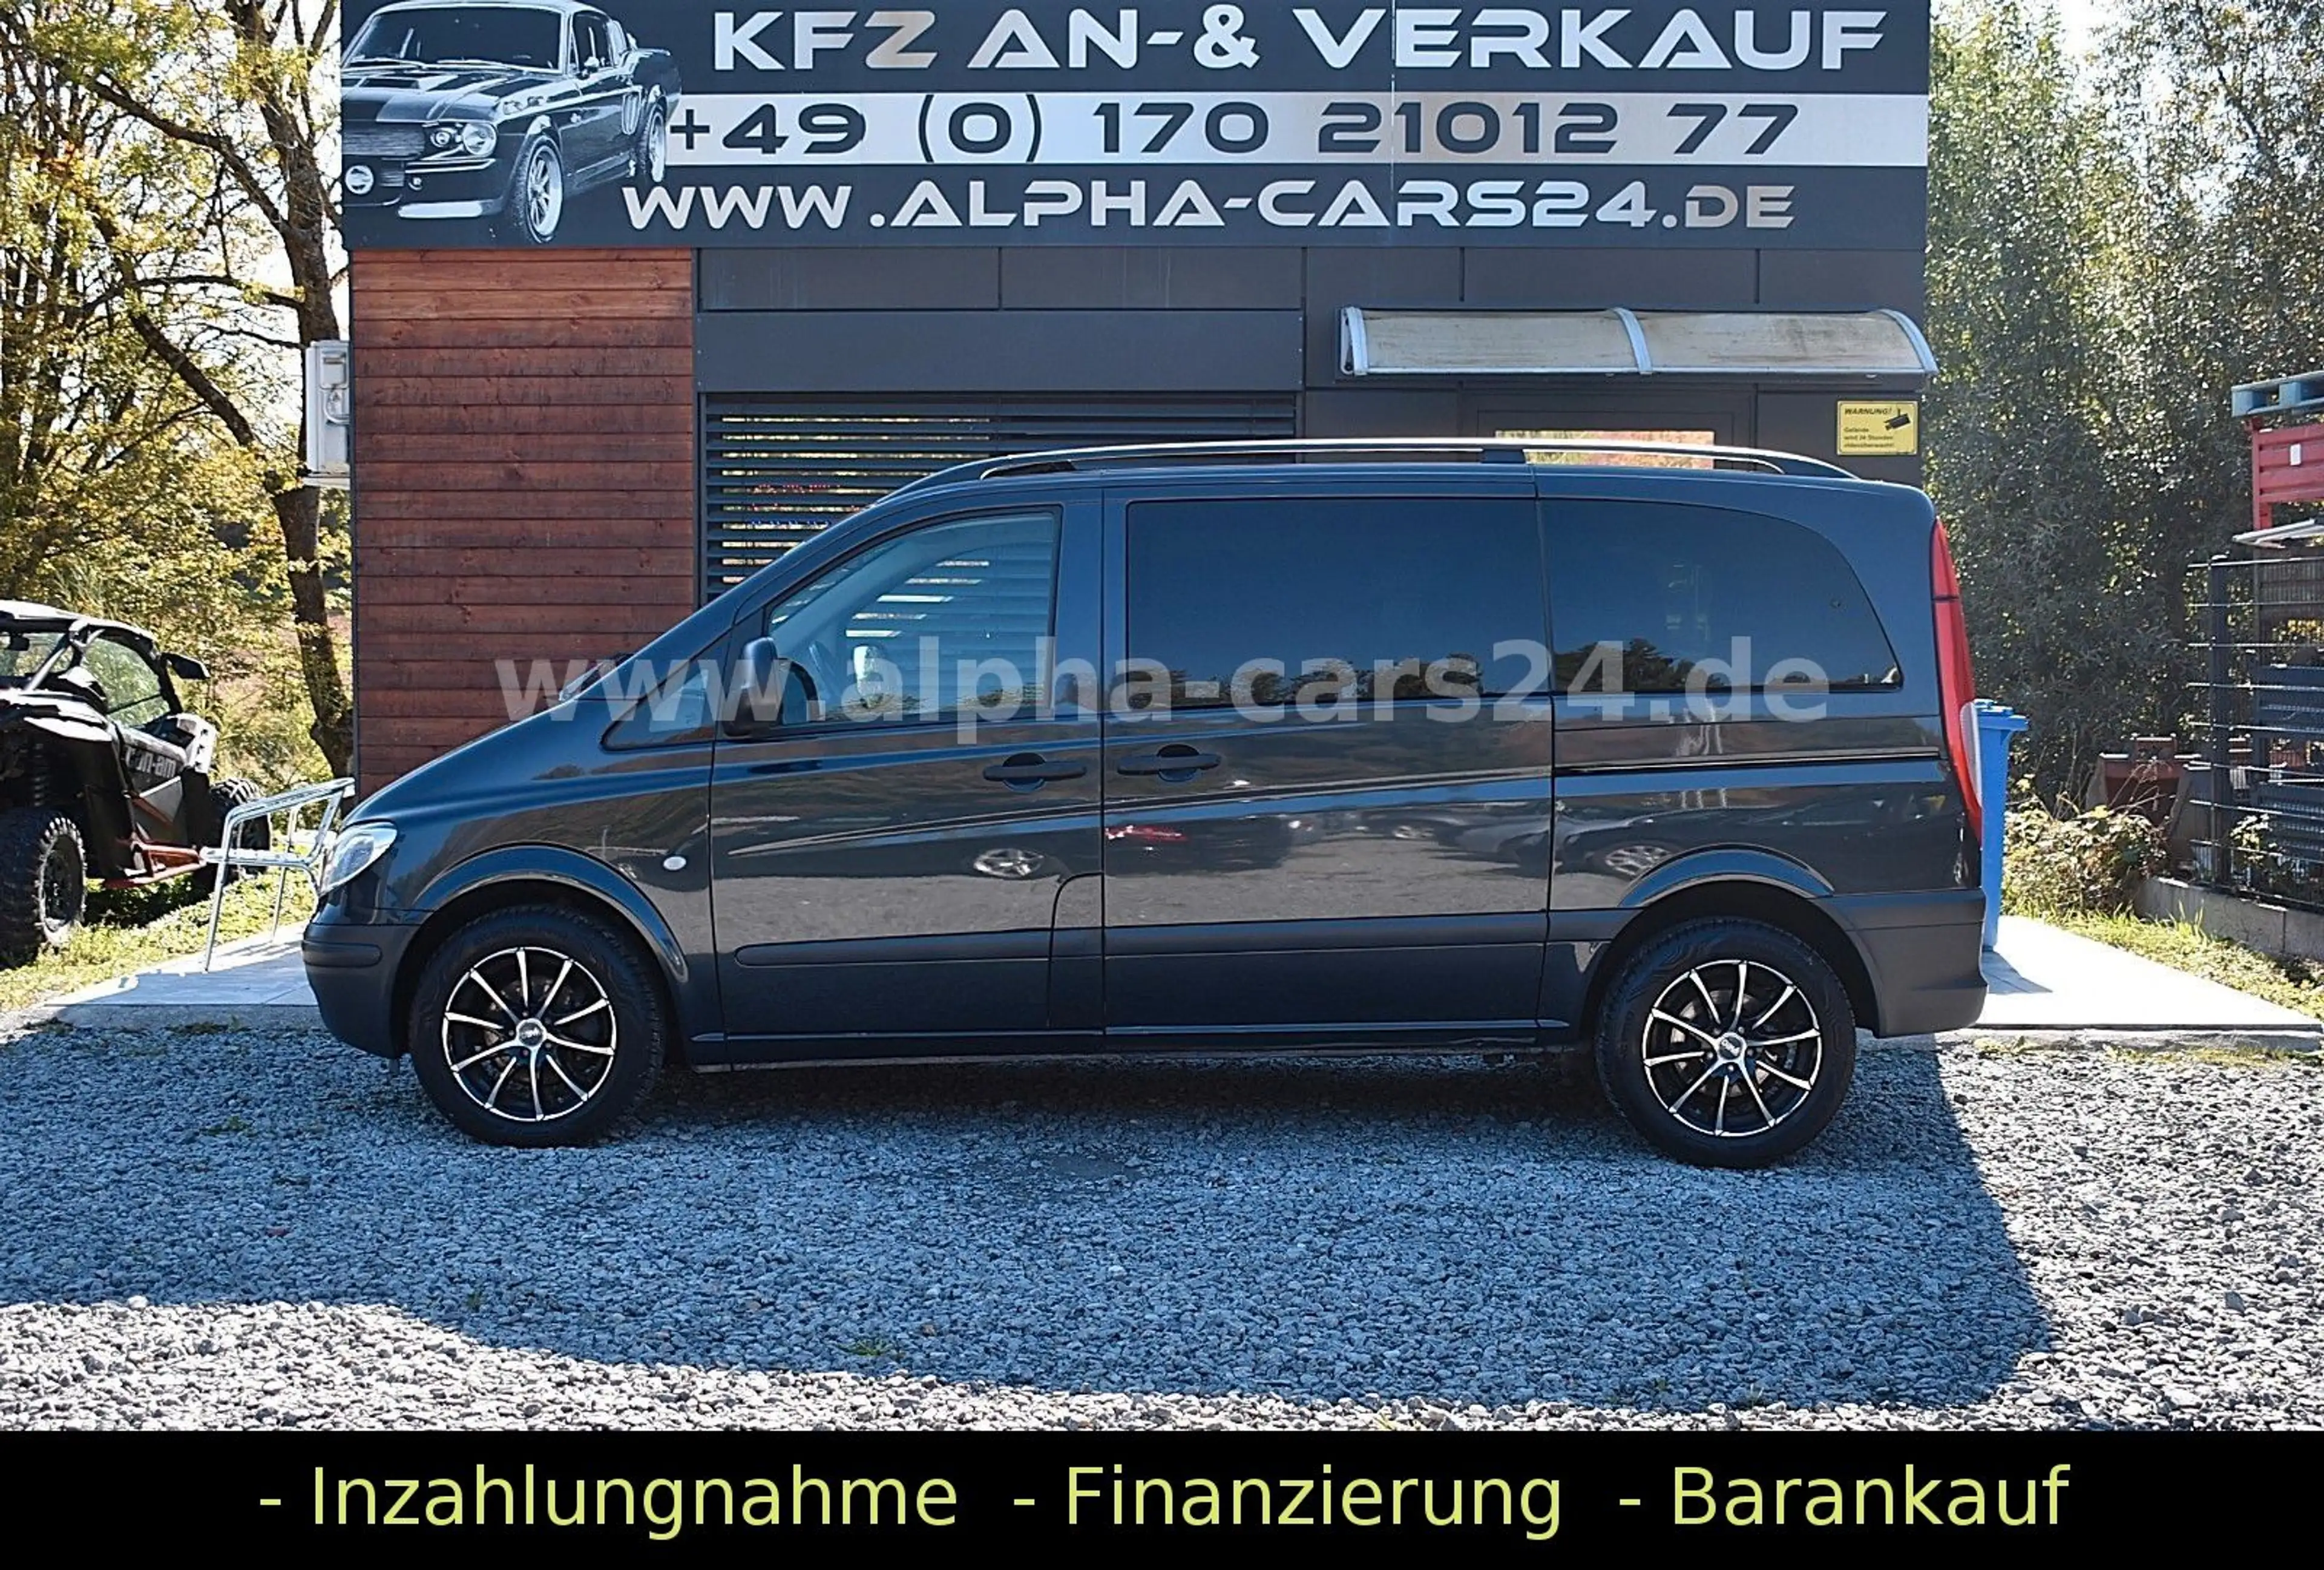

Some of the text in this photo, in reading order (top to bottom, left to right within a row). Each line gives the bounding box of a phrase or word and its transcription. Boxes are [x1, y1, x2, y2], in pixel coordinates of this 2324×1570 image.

[714, 10, 938, 71] KFZ
[1292, 7, 1888, 71] VERKAUF
[669, 93, 1799, 163] +49 (0) 170 21012 77
